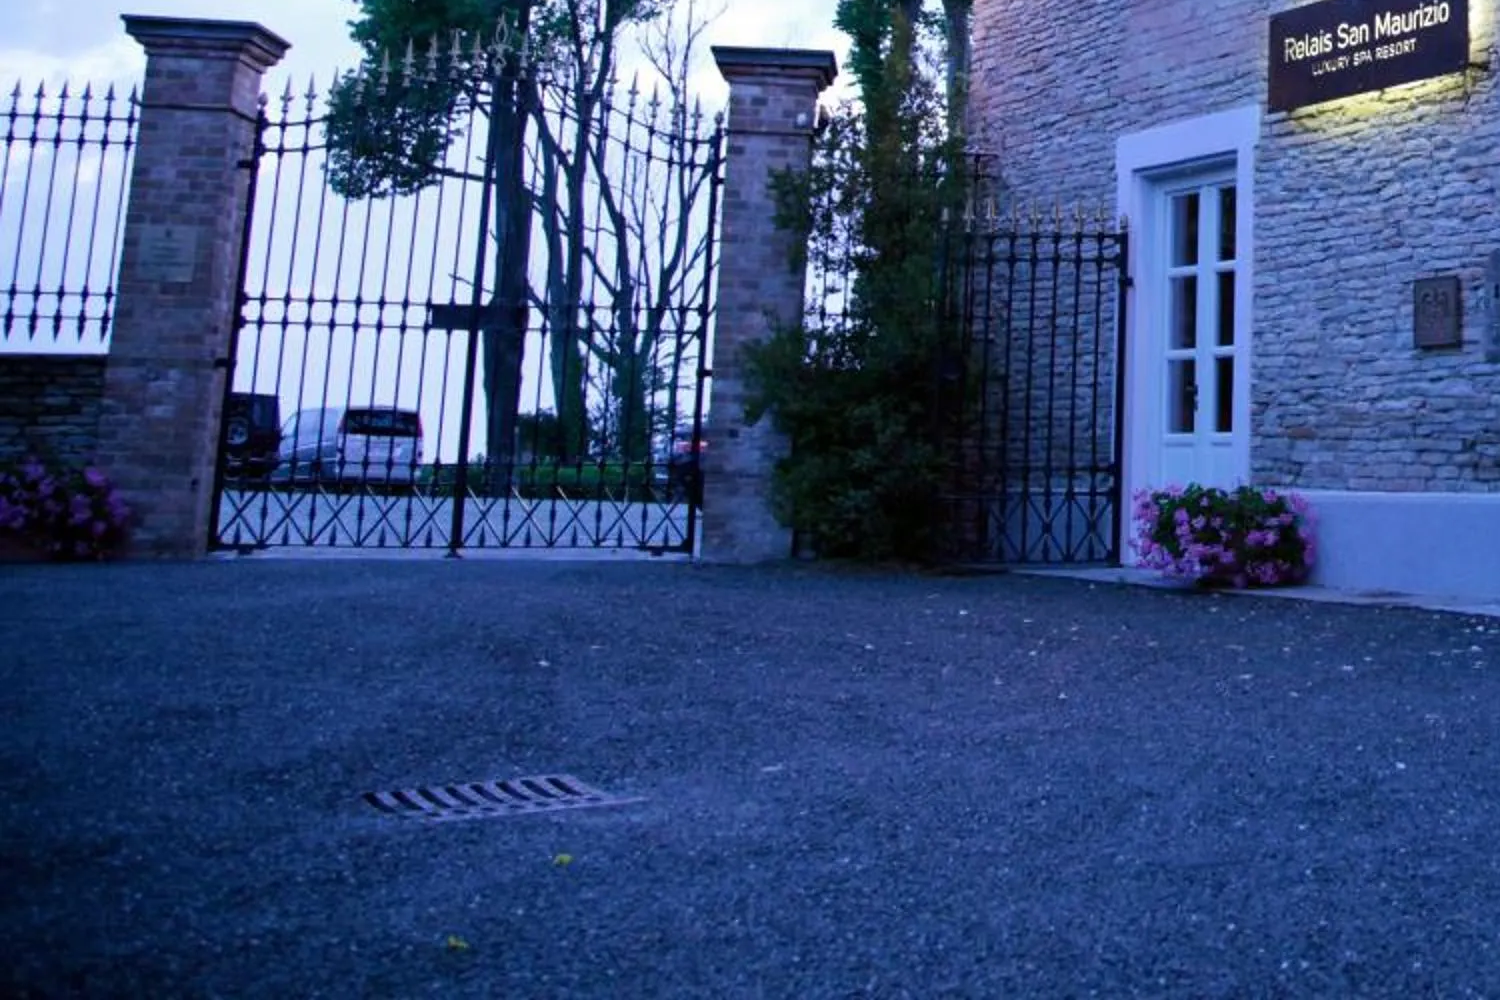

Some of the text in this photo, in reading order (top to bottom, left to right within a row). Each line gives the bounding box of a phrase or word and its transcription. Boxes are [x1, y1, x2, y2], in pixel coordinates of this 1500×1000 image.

[1284, 0, 1450, 62] Relais San Maurizio
[1312, 38, 1417, 76] LUXURY SPA RESORT
